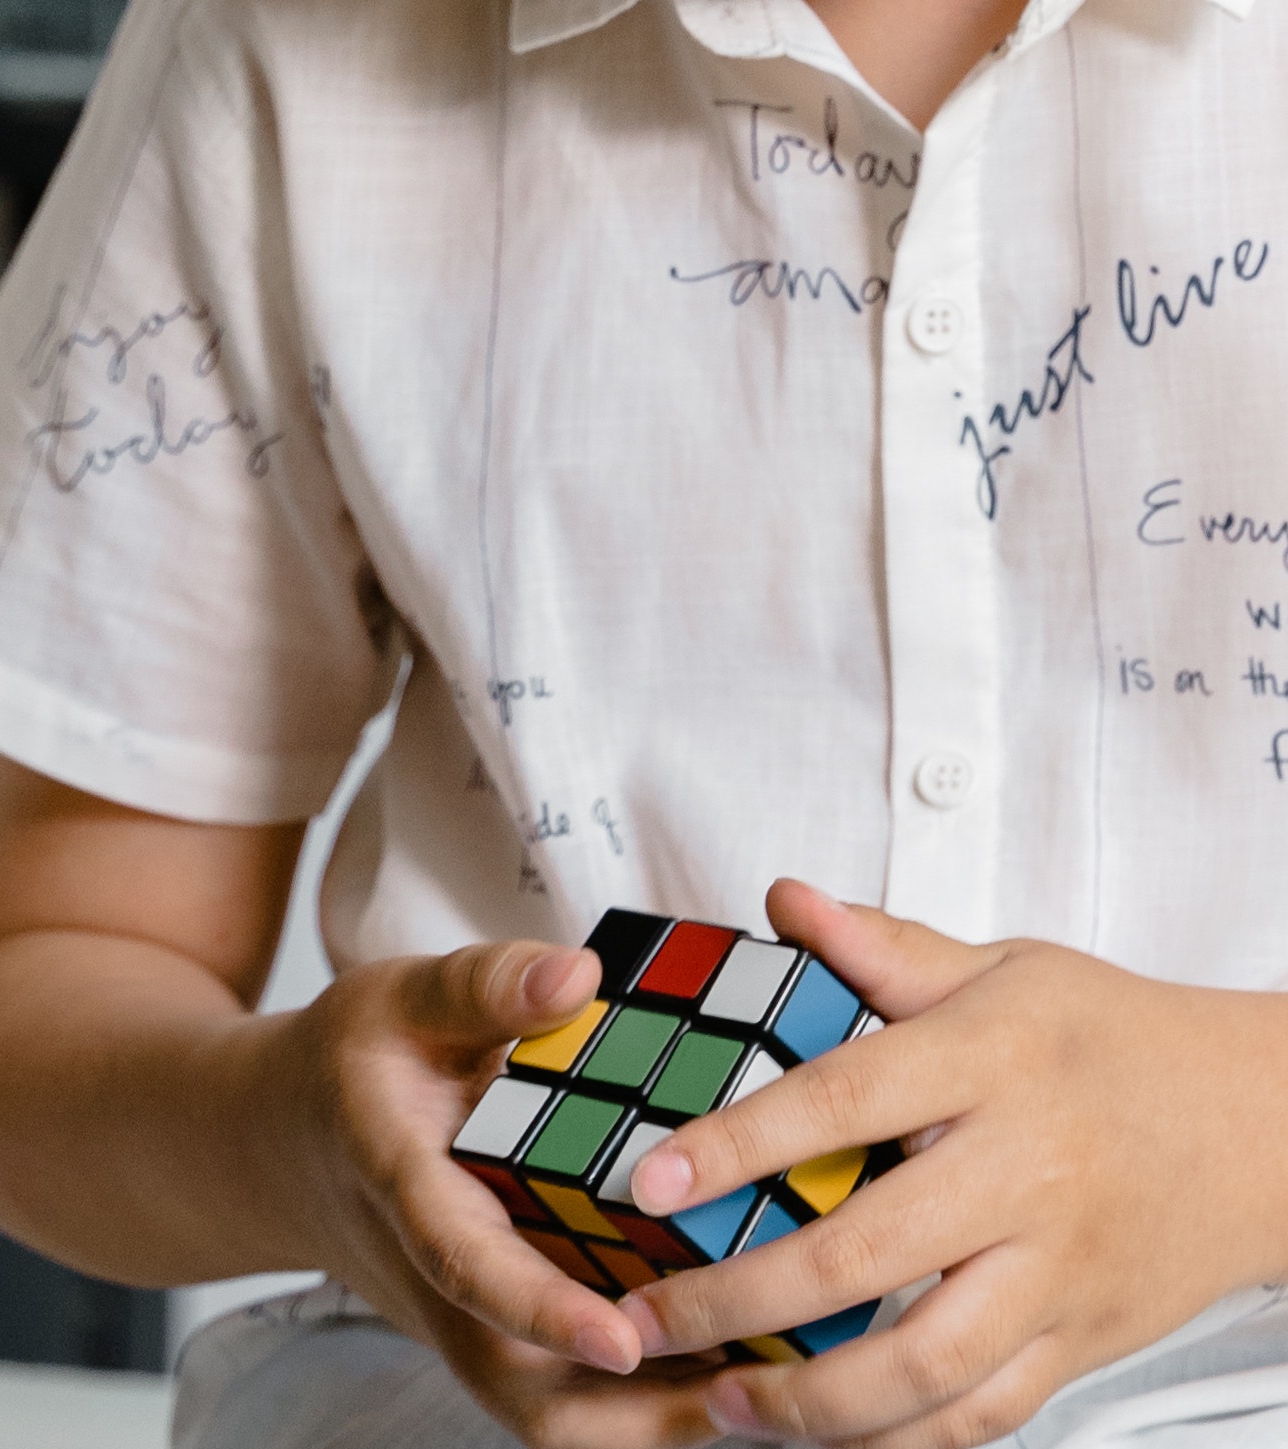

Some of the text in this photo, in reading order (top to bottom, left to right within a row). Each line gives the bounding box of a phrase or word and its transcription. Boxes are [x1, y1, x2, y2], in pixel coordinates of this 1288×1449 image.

[957, 237, 1270, 522] just live
[1173, 665, 1215, 699] on
